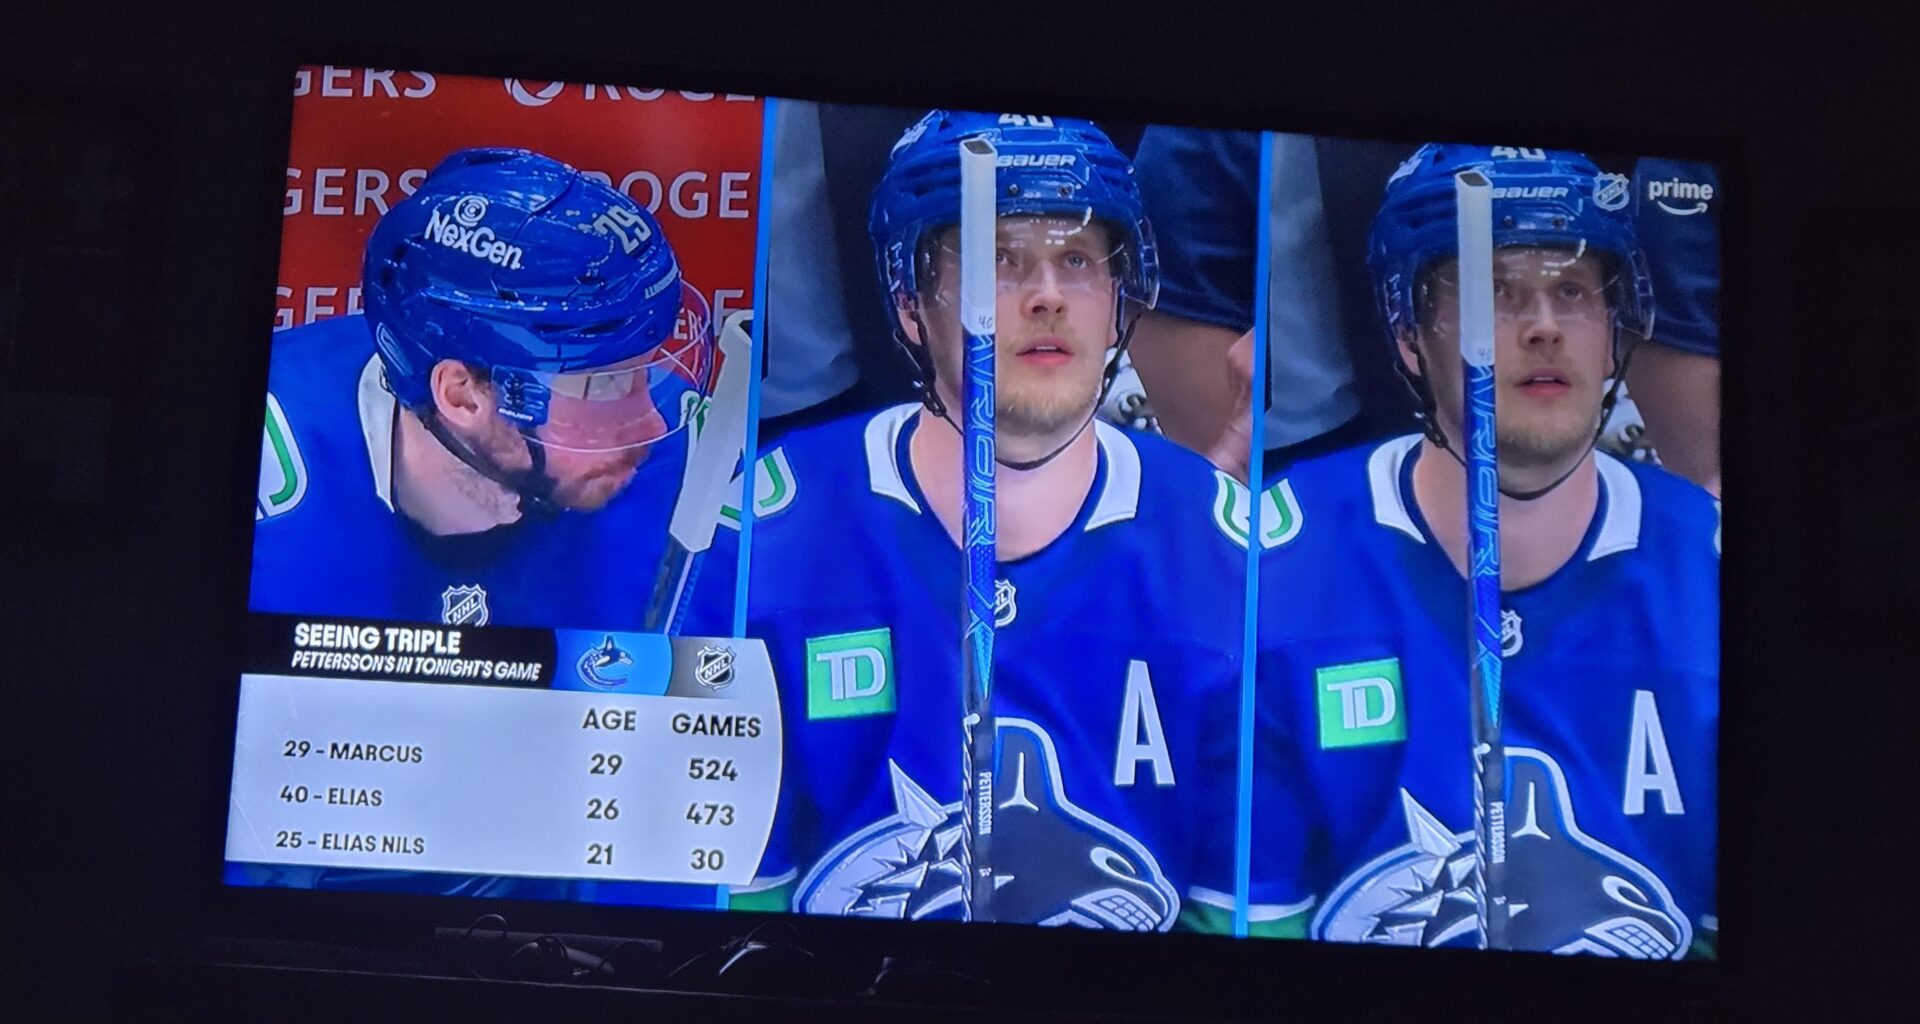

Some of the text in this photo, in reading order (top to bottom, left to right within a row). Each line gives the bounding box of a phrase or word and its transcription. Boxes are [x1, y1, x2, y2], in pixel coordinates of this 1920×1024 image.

[580, 171, 750, 219] OGE
[1649, 178, 1714, 200] prime
[592, 205, 651, 254] 29
[452, 596, 478, 623] NHL
[294, 622, 462, 655] SEEING TRIPLE
[291, 651, 543, 681] PETTERSSON'S IN TONIGHT'S GAME
[704, 658, 728, 679] NHL
[815, 646, 887, 700] TD
[1326, 677, 1397, 730] TD
[582, 708, 762, 738] AGE GAMES
[1114, 659, 1176, 786] A
[283, 740, 311, 757] 29
[329, 742, 423, 763] MARCUS
[1622, 690, 1685, 815] A
[590, 753, 738, 781] 29 524
[280, 785, 309, 803] 40
[327, 787, 383, 807] ELIAS
[587, 798, 735, 826] 26 473
[275, 830, 302, 848] 25
[321, 833, 377, 852] ELIAS
[381, 836, 425, 855] NILS
[587, 843, 725, 871] 21 30
